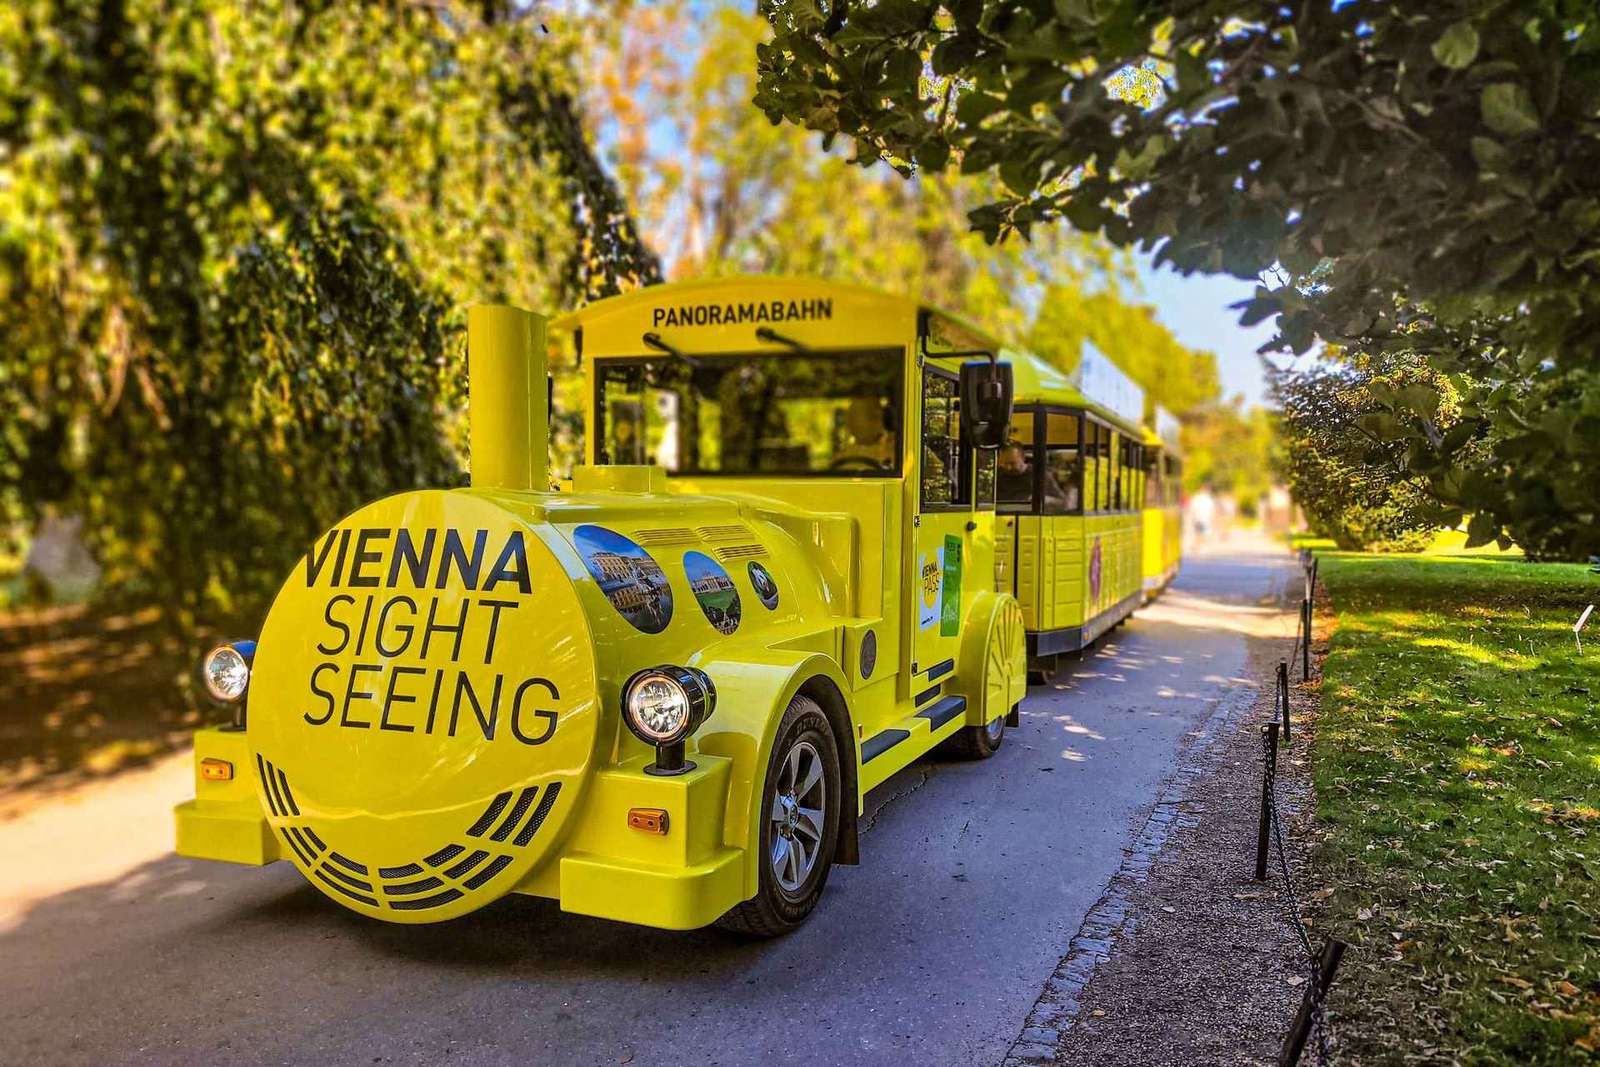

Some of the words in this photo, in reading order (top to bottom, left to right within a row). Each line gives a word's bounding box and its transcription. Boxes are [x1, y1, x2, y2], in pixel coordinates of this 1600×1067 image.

[653, 297, 833, 327] PANORAMABAHN
[306, 528, 532, 594] VIENNA
[317, 594, 519, 664] SIGHT
[303, 662, 560, 745] SEEING
